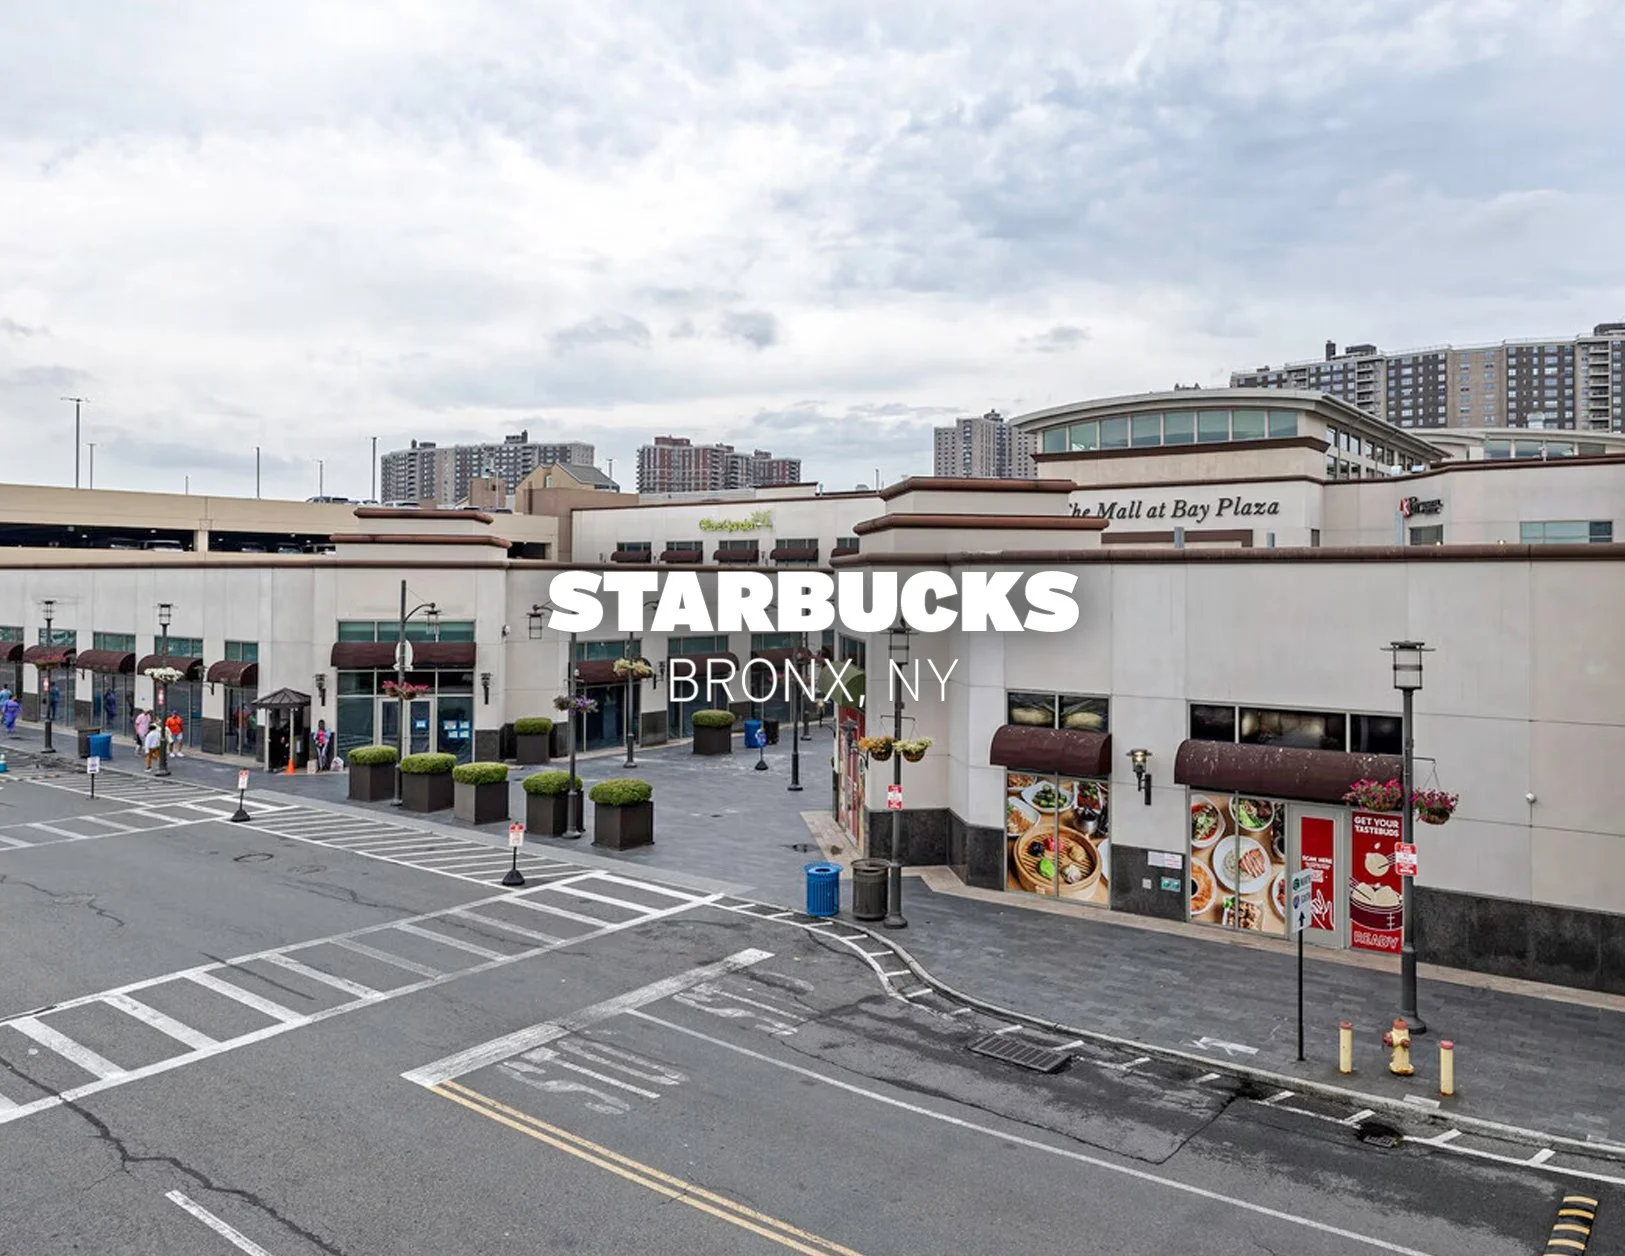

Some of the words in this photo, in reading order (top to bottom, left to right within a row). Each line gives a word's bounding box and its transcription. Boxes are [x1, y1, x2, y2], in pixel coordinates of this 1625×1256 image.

[1068, 502, 1091, 517] he
[1097, 500, 1140, 519] Mall
[1146, 502, 1166, 519] at
[1170, 499, 1210, 524] Bay
[1216, 496, 1280, 518] Plaza
[1354, 816, 1372, 825] GET
[1374, 818, 1399, 829] YOUR
[1354, 825, 1400, 837] TASTEBUDS
[1354, 931, 1399, 949] READY
[496, 1033, 691, 1116] STO
